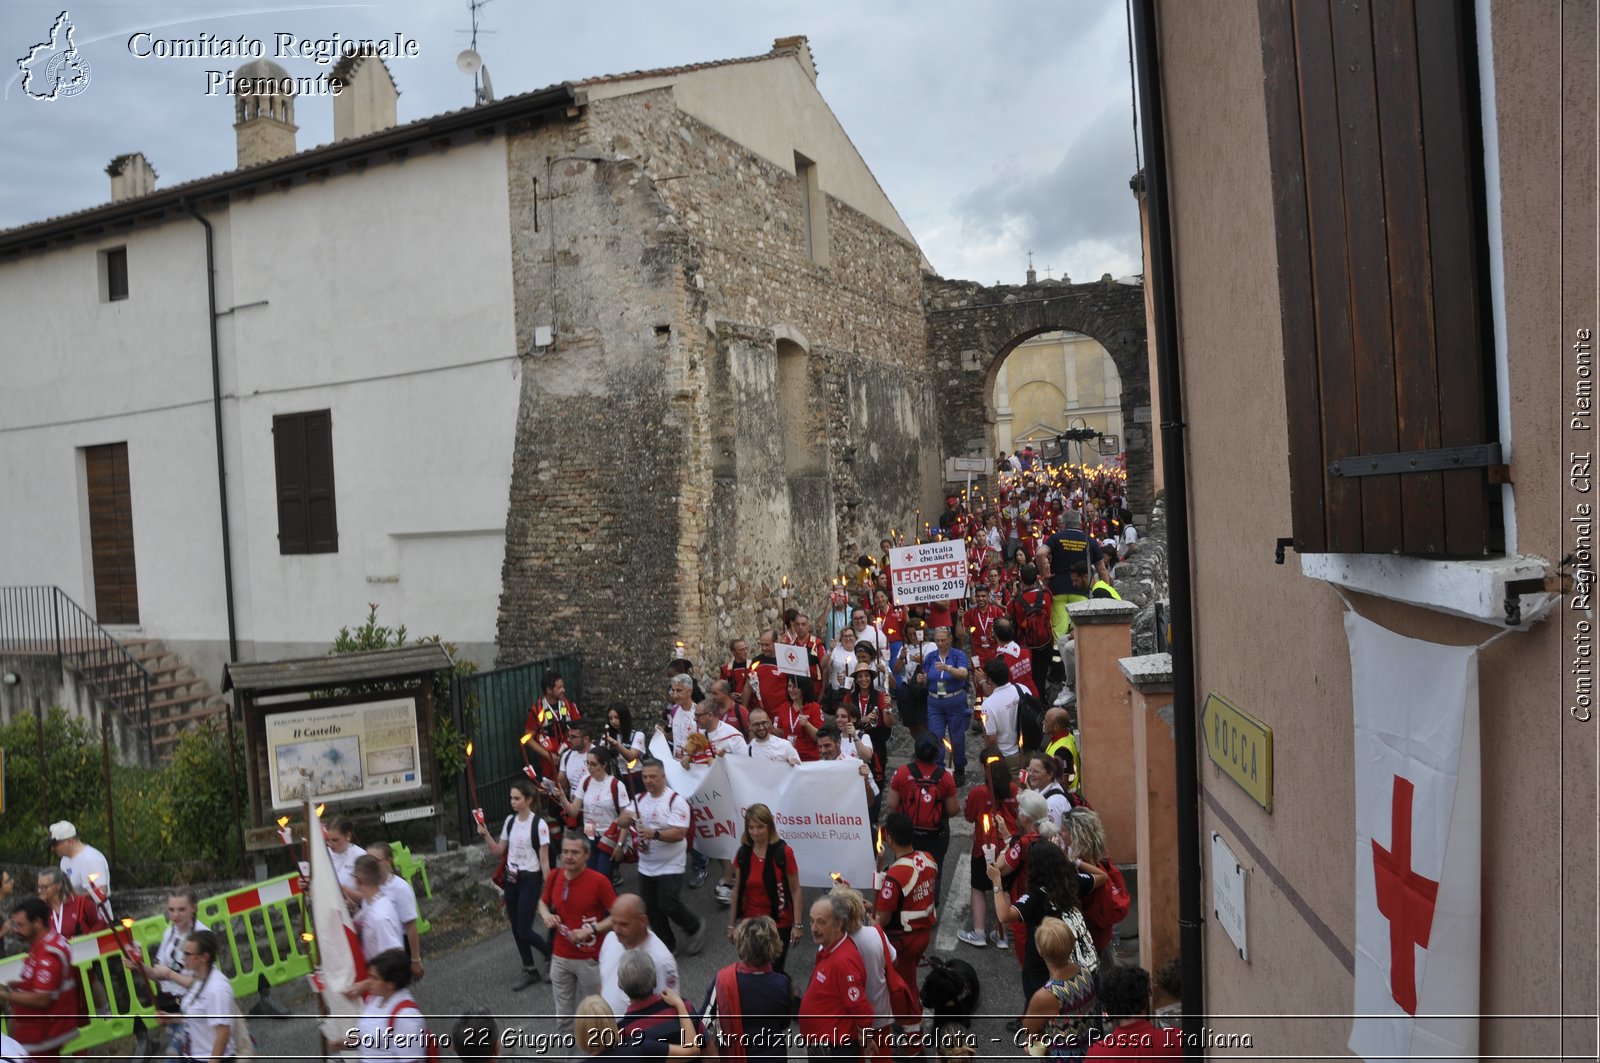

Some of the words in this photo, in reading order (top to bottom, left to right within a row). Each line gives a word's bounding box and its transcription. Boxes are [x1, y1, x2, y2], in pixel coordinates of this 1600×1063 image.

[919, 546, 953, 556] Un'Italia
[893, 567, 939, 585] LECCE
[942, 579, 965, 590] 2019
[914, 593, 950, 602] #crilecce
[304, 725, 341, 737] Castello
[1214, 711, 1258, 784] ROCCA
[692, 806, 714, 822] RI
[776, 812, 811, 825] Rossa
[815, 812, 862, 826] Italiana
